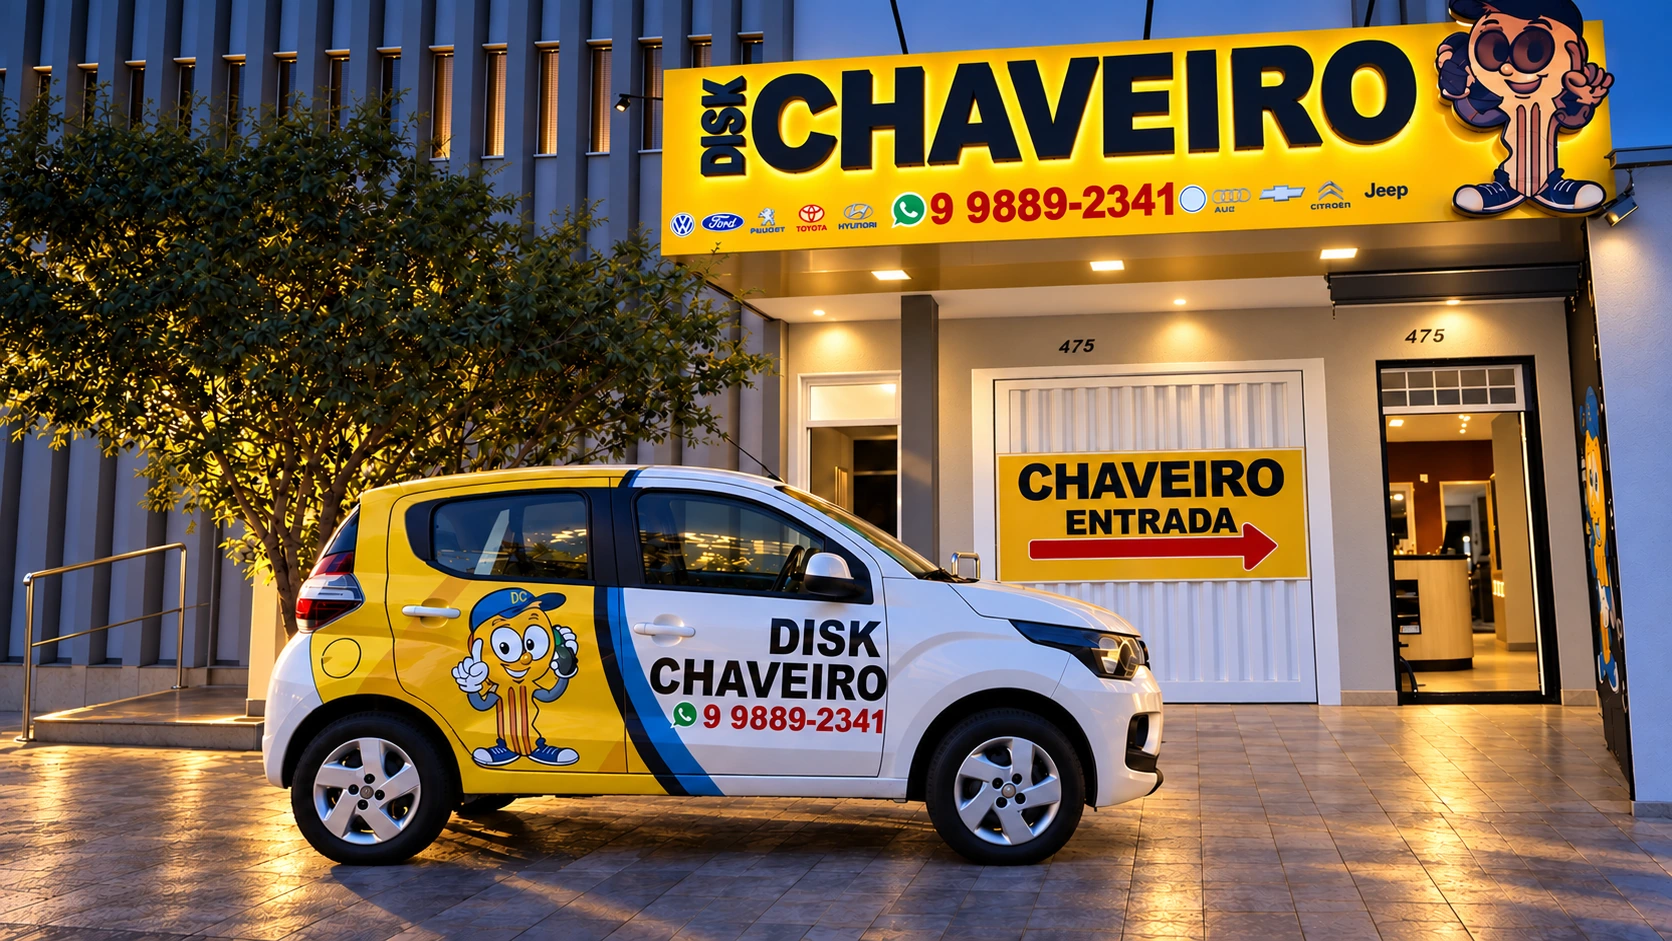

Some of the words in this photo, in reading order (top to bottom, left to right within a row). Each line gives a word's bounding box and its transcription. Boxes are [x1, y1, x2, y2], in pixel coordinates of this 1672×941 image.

[752, 40, 1417, 174] CHAVEIRO
[701, 76, 746, 177] DISK
[930, 192, 953, 225] 9
[966, 182, 1174, 223] 9889-2341
[1364, 183, 1408, 199] Jeep
[707, 214, 738, 229] Ford
[796, 225, 827, 233] TOYOTA
[1059, 338, 1095, 354] 475
[1405, 328, 1445, 344] 475
[1018, 458, 1284, 501] CHAVEIRO
[1066, 507, 1238, 535] ENTRADA
[511, 591, 527, 604] DC
[770, 618, 881, 658] DISK
[650, 657, 887, 701] CHAVEIRO
[703, 704, 721, 729] 9
[731, 706, 884, 734] 9889-2341
